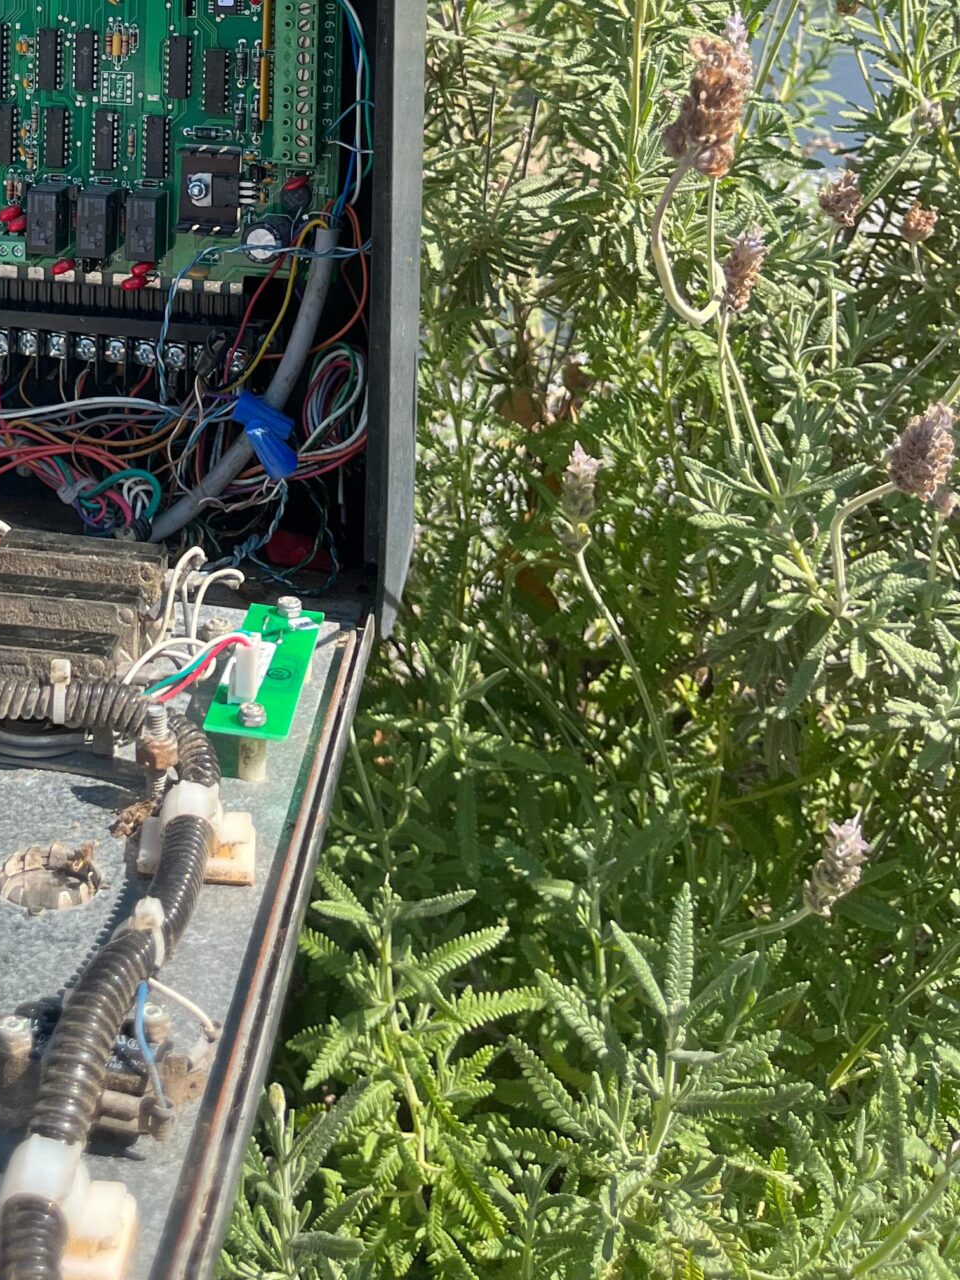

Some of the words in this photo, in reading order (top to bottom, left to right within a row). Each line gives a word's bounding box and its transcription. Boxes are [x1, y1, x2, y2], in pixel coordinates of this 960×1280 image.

[325, 2, 336, 15] 10
[324, 21, 336, 30] 9
[324, 35, 335, 44] 8
[324, 52, 334, 60] 7
[324, 69, 334, 77] 6
[322, 85, 333, 93] 5
[322, 102, 333, 110] 4
